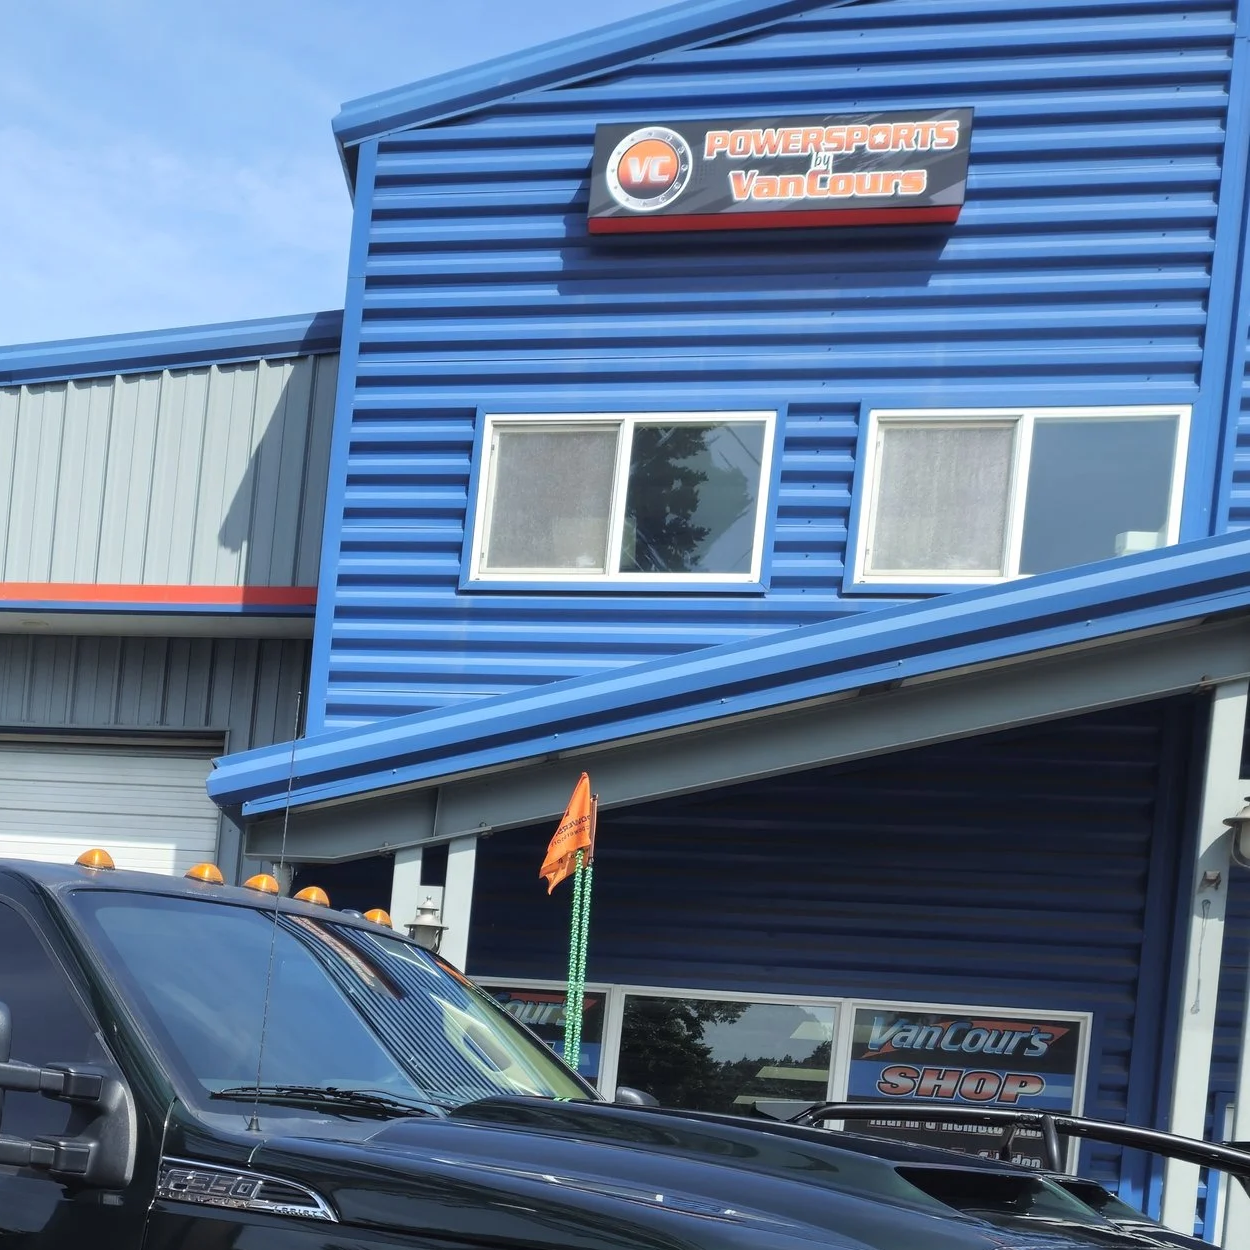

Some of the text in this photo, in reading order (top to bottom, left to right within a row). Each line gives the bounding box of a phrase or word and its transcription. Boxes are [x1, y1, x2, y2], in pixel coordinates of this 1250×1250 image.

[703, 121, 960, 159] POWERSPORTS
[628, 156, 671, 184] VC
[812, 152, 834, 172] by
[729, 169, 928, 200] VanCours
[876, 1065, 1046, 1105] SHOP
